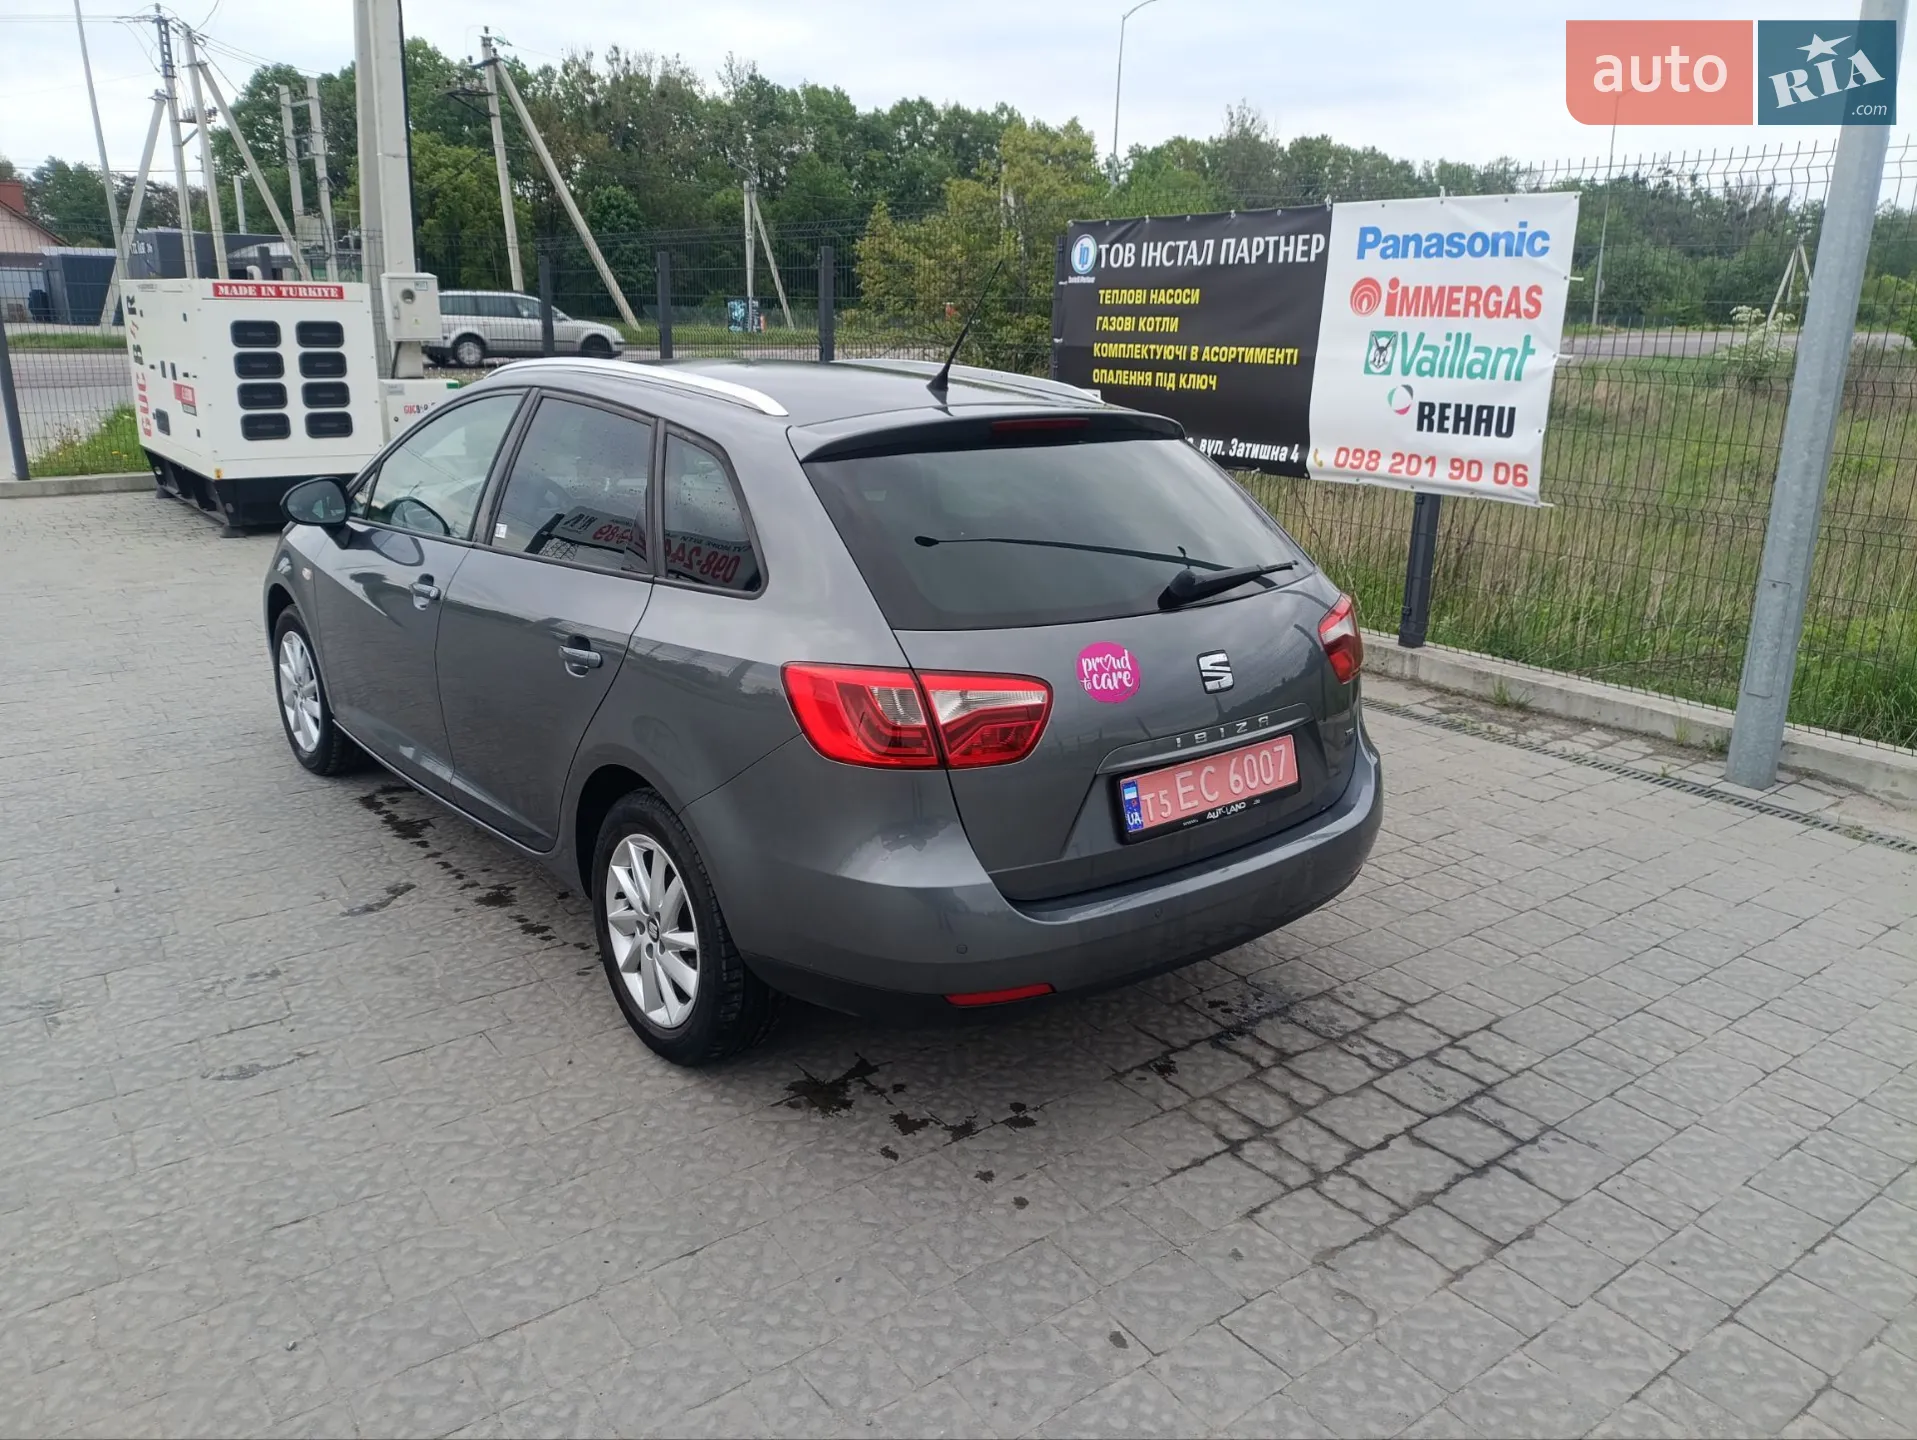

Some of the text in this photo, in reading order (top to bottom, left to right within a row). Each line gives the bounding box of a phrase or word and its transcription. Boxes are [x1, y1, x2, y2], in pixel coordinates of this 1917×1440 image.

[1098, 233, 1326, 269] ТОВ ІНСТАЛ ПАРТНЕР
[1356, 220, 1551, 260] Panasonic
[217, 285, 339, 298] MADE IN TURKIYE
[1098, 287, 1201, 305] ТЕПЛОВІ НАСОСИ
[1095, 316, 1180, 333] ГАЗОВІ КОТЛИ
[1093, 342, 1299, 366] КОМПЛЕКТУЮЧІ В АСОРТИМЕНТІ
[1398, 331, 1537, 382] Vaillant
[1092, 368, 1218, 391] ОПАЛЕННЯ ПІД КЛЮЧ
[1416, 401, 1516, 439] REHAU
[1199, 438, 1225, 457] вул.
[1228, 437, 1288, 462] Затишна
[1290, 443, 1300, 463] 4
[1333, 446, 1529, 487] 098 201 90 06
[1092, 670, 1134, 691] care
[1175, 715, 1269, 748] IBIZA
[1174, 765, 1220, 811] EC
[1229, 744, 1286, 795] 6007
[1127, 812, 1143, 826] UA
